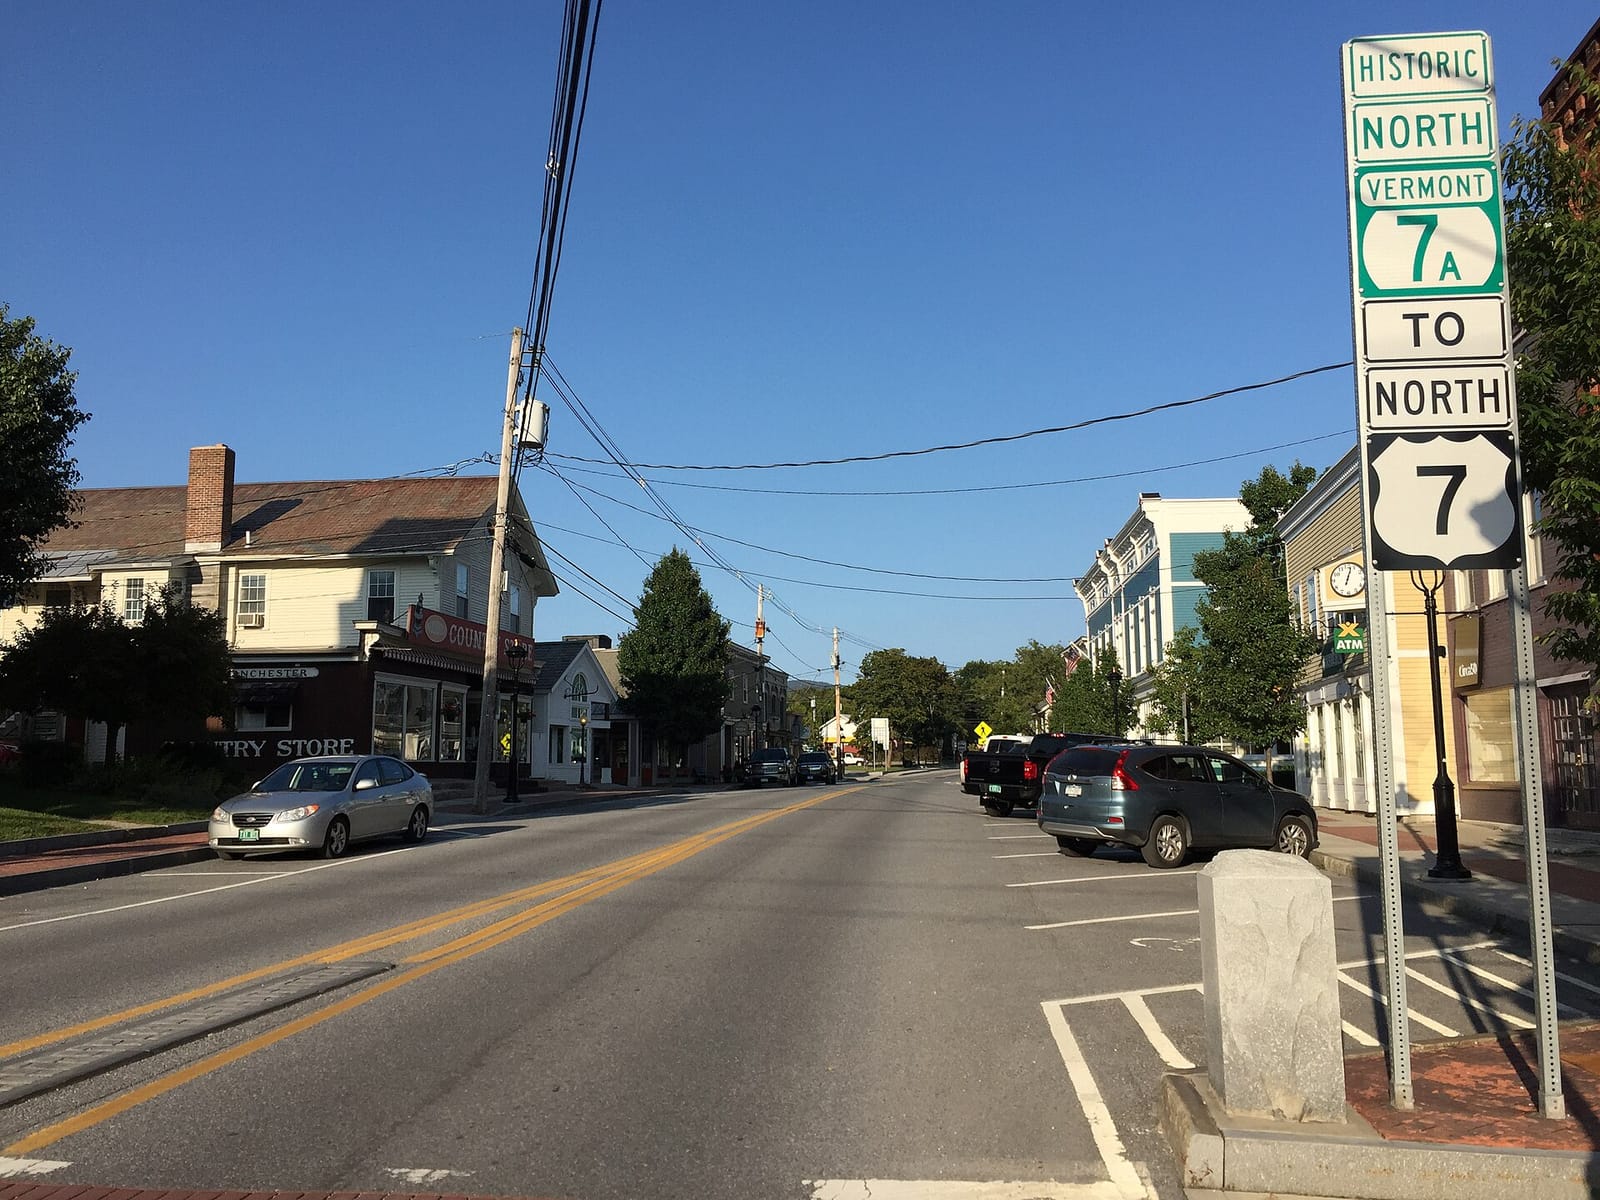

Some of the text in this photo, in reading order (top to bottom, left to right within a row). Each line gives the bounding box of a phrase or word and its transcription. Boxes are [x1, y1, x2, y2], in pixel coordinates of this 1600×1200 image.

[1359, 48, 1478, 82] HISTORIC
[1363, 111, 1483, 149] NORTH
[1366, 173, 1486, 201] VERMONT
[1402, 311, 1465, 348] TO
[1376, 378, 1501, 416] NORTH
[1416, 464, 1468, 536] 7
[1336, 639, 1364, 650] ATM
[236, 668, 308, 679] NCHESTER
[276, 738, 355, 757] STORE
